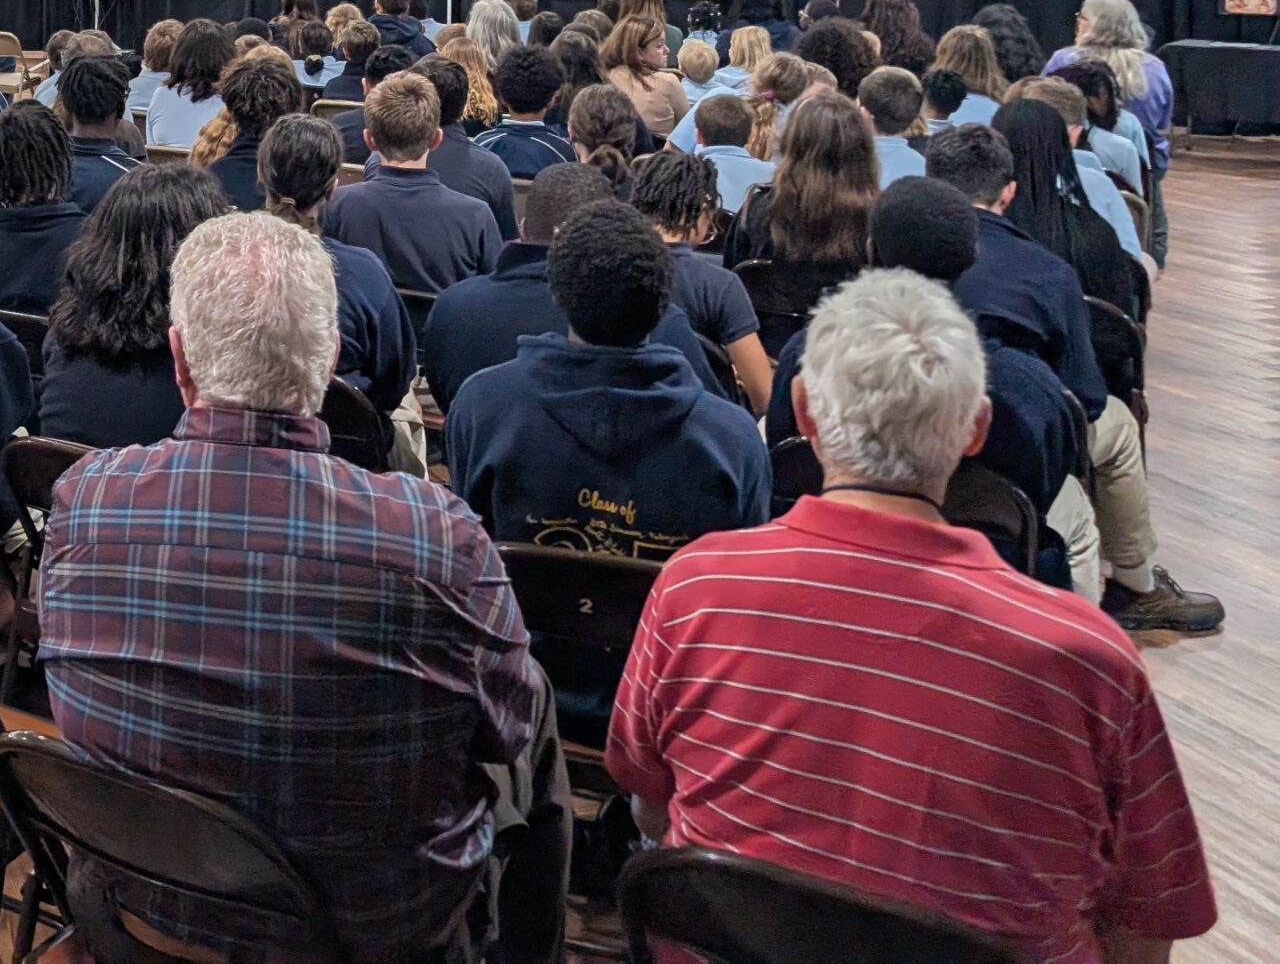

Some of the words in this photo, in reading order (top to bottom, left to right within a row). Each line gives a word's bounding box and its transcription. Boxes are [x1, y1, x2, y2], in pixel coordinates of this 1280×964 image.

[578, 488, 618, 514] Class
[619, 500, 637, 524] of
[579, 598, 593, 614] 2
